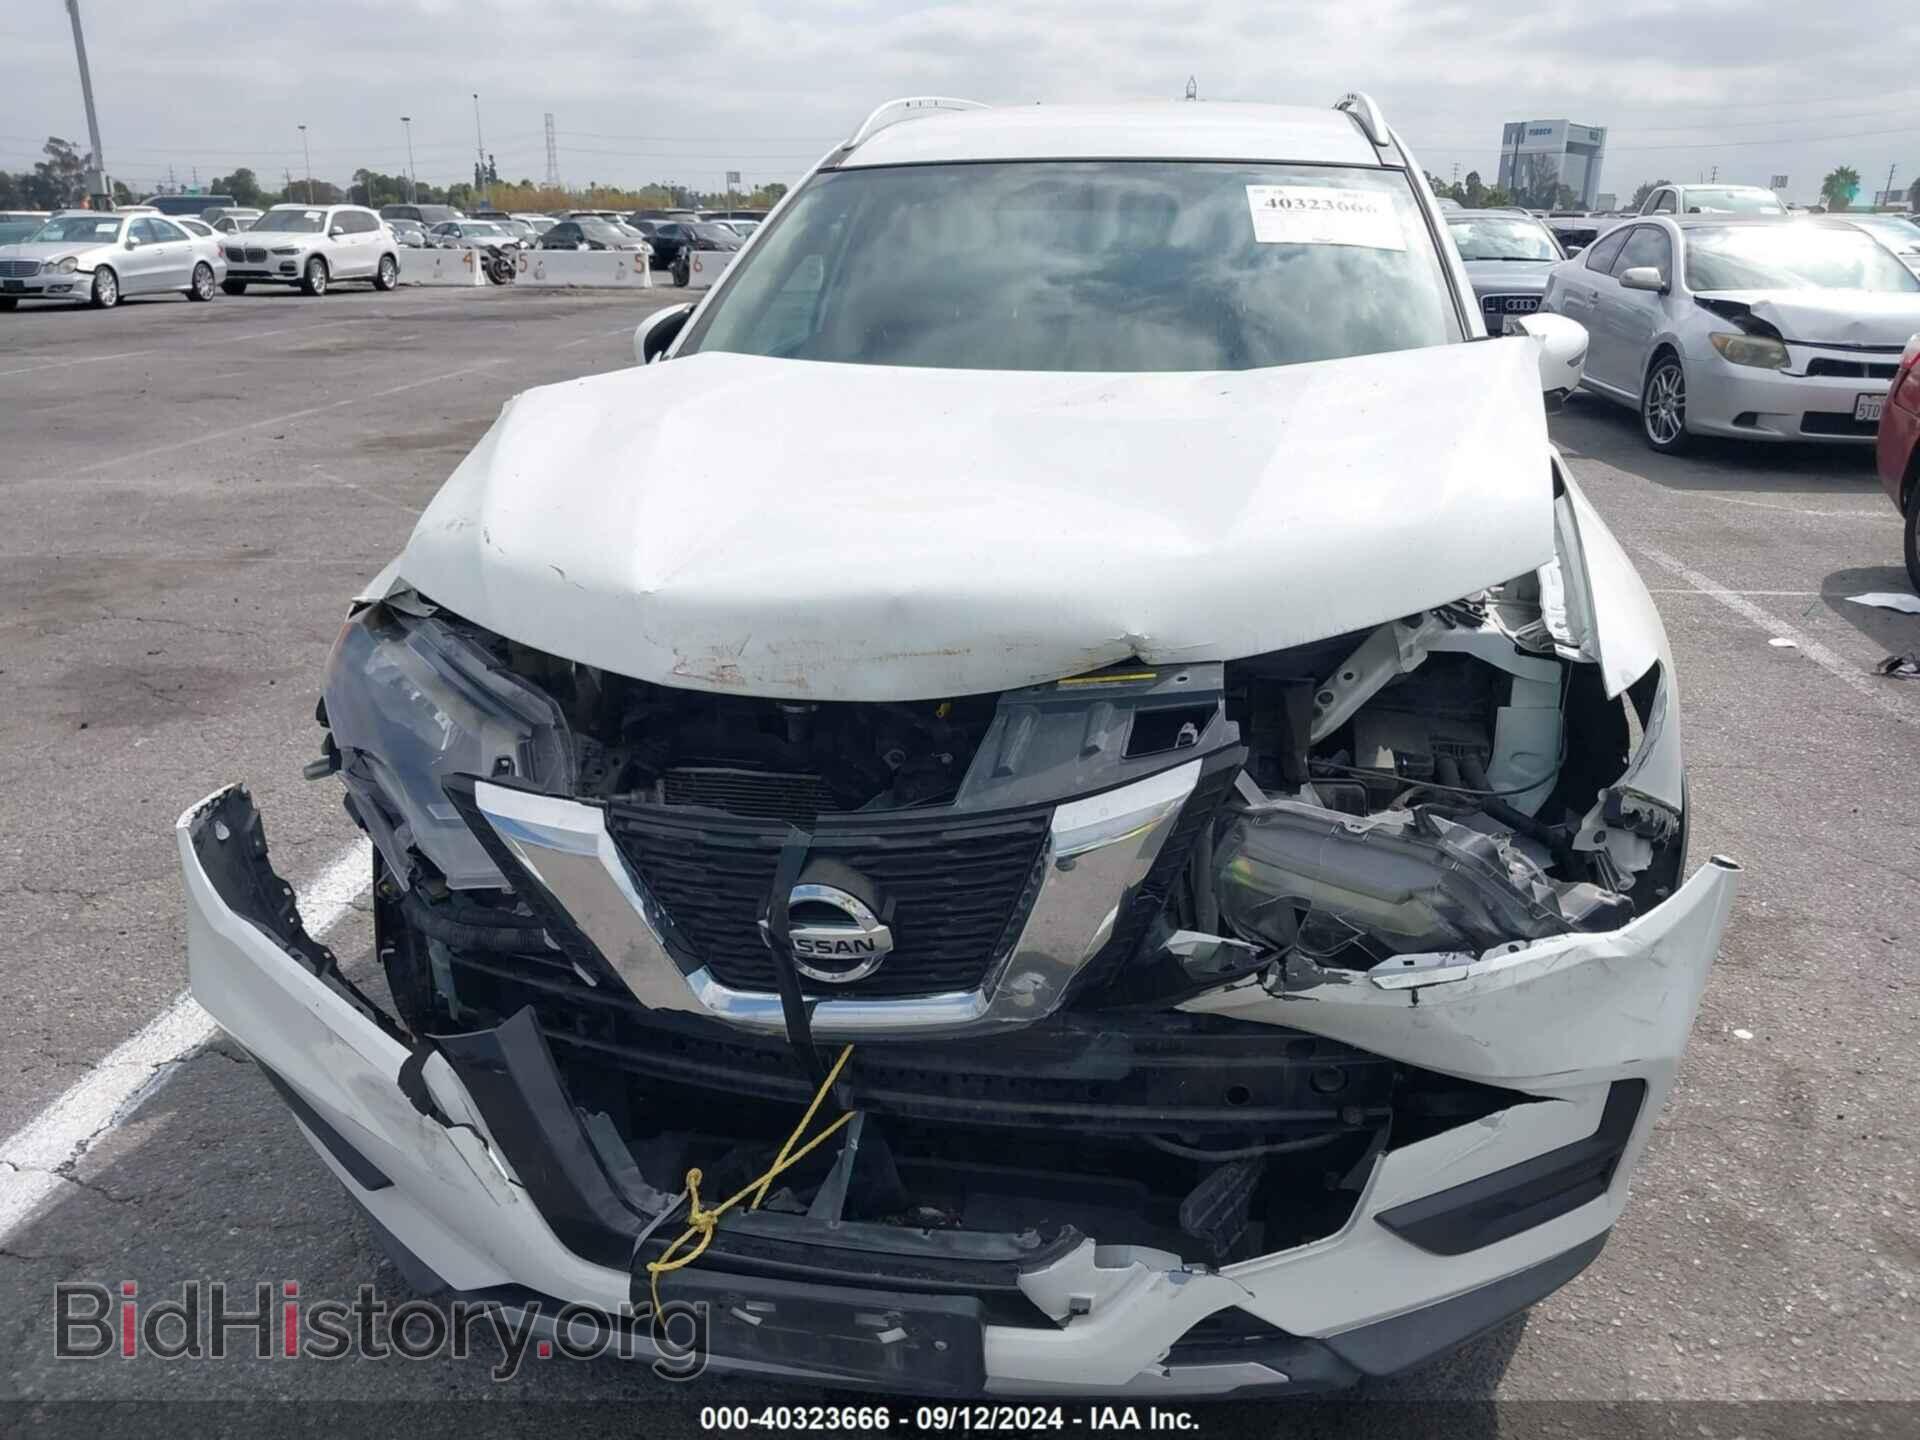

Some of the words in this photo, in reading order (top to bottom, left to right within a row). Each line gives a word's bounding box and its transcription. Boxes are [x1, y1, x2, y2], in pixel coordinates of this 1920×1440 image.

[463, 252, 473, 273] 4
[519, 253, 529, 273] 5
[634, 254, 645, 273] 5
[693, 254, 703, 273] 6
